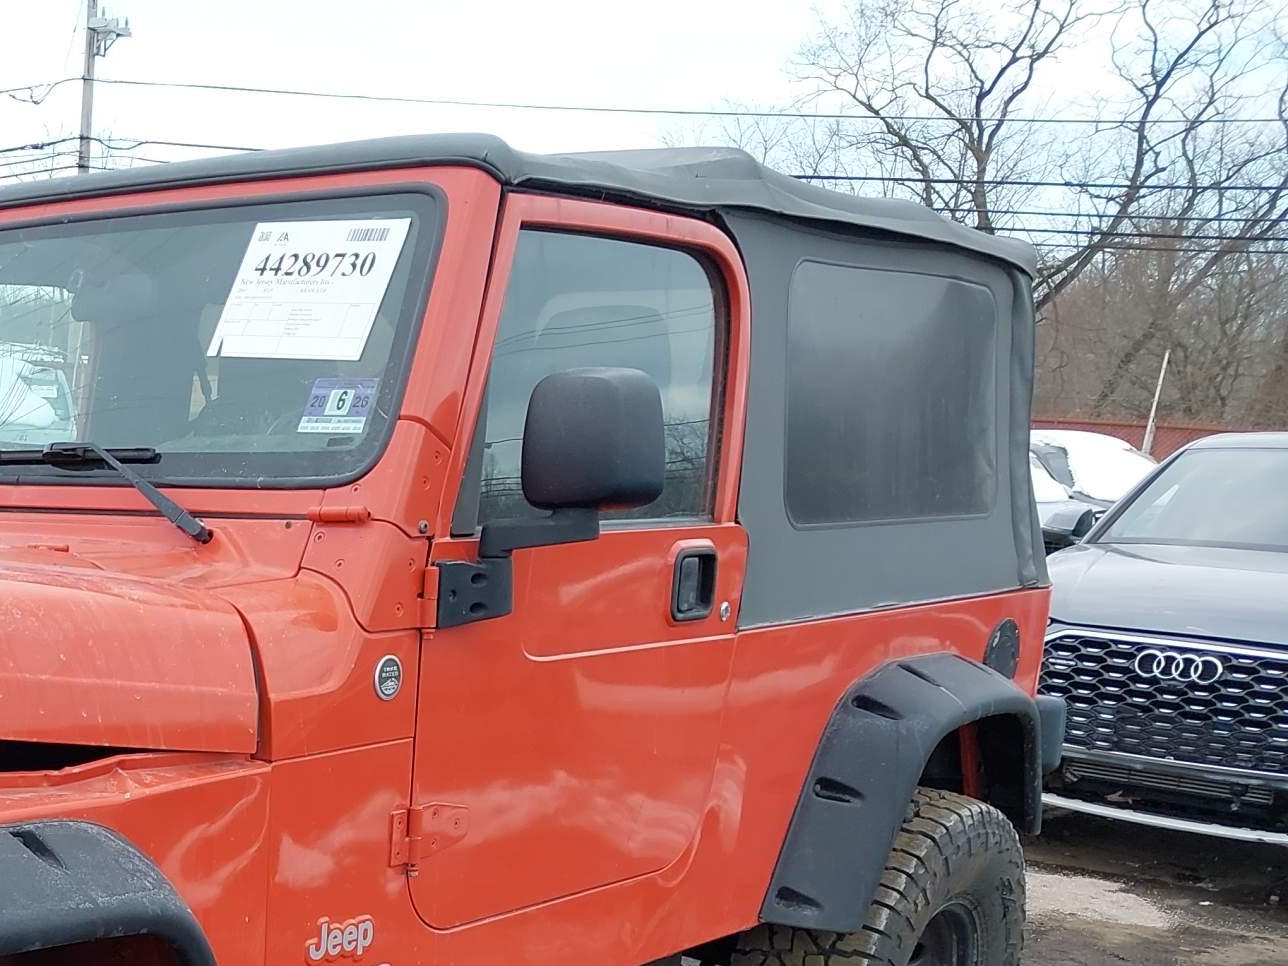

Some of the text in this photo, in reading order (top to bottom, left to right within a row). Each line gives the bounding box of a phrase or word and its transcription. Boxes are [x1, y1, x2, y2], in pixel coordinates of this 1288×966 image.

[254, 251, 377, 278] 44289730
[310, 390, 370, 411] 20 6 26
[308, 920, 374, 961] Jeep
